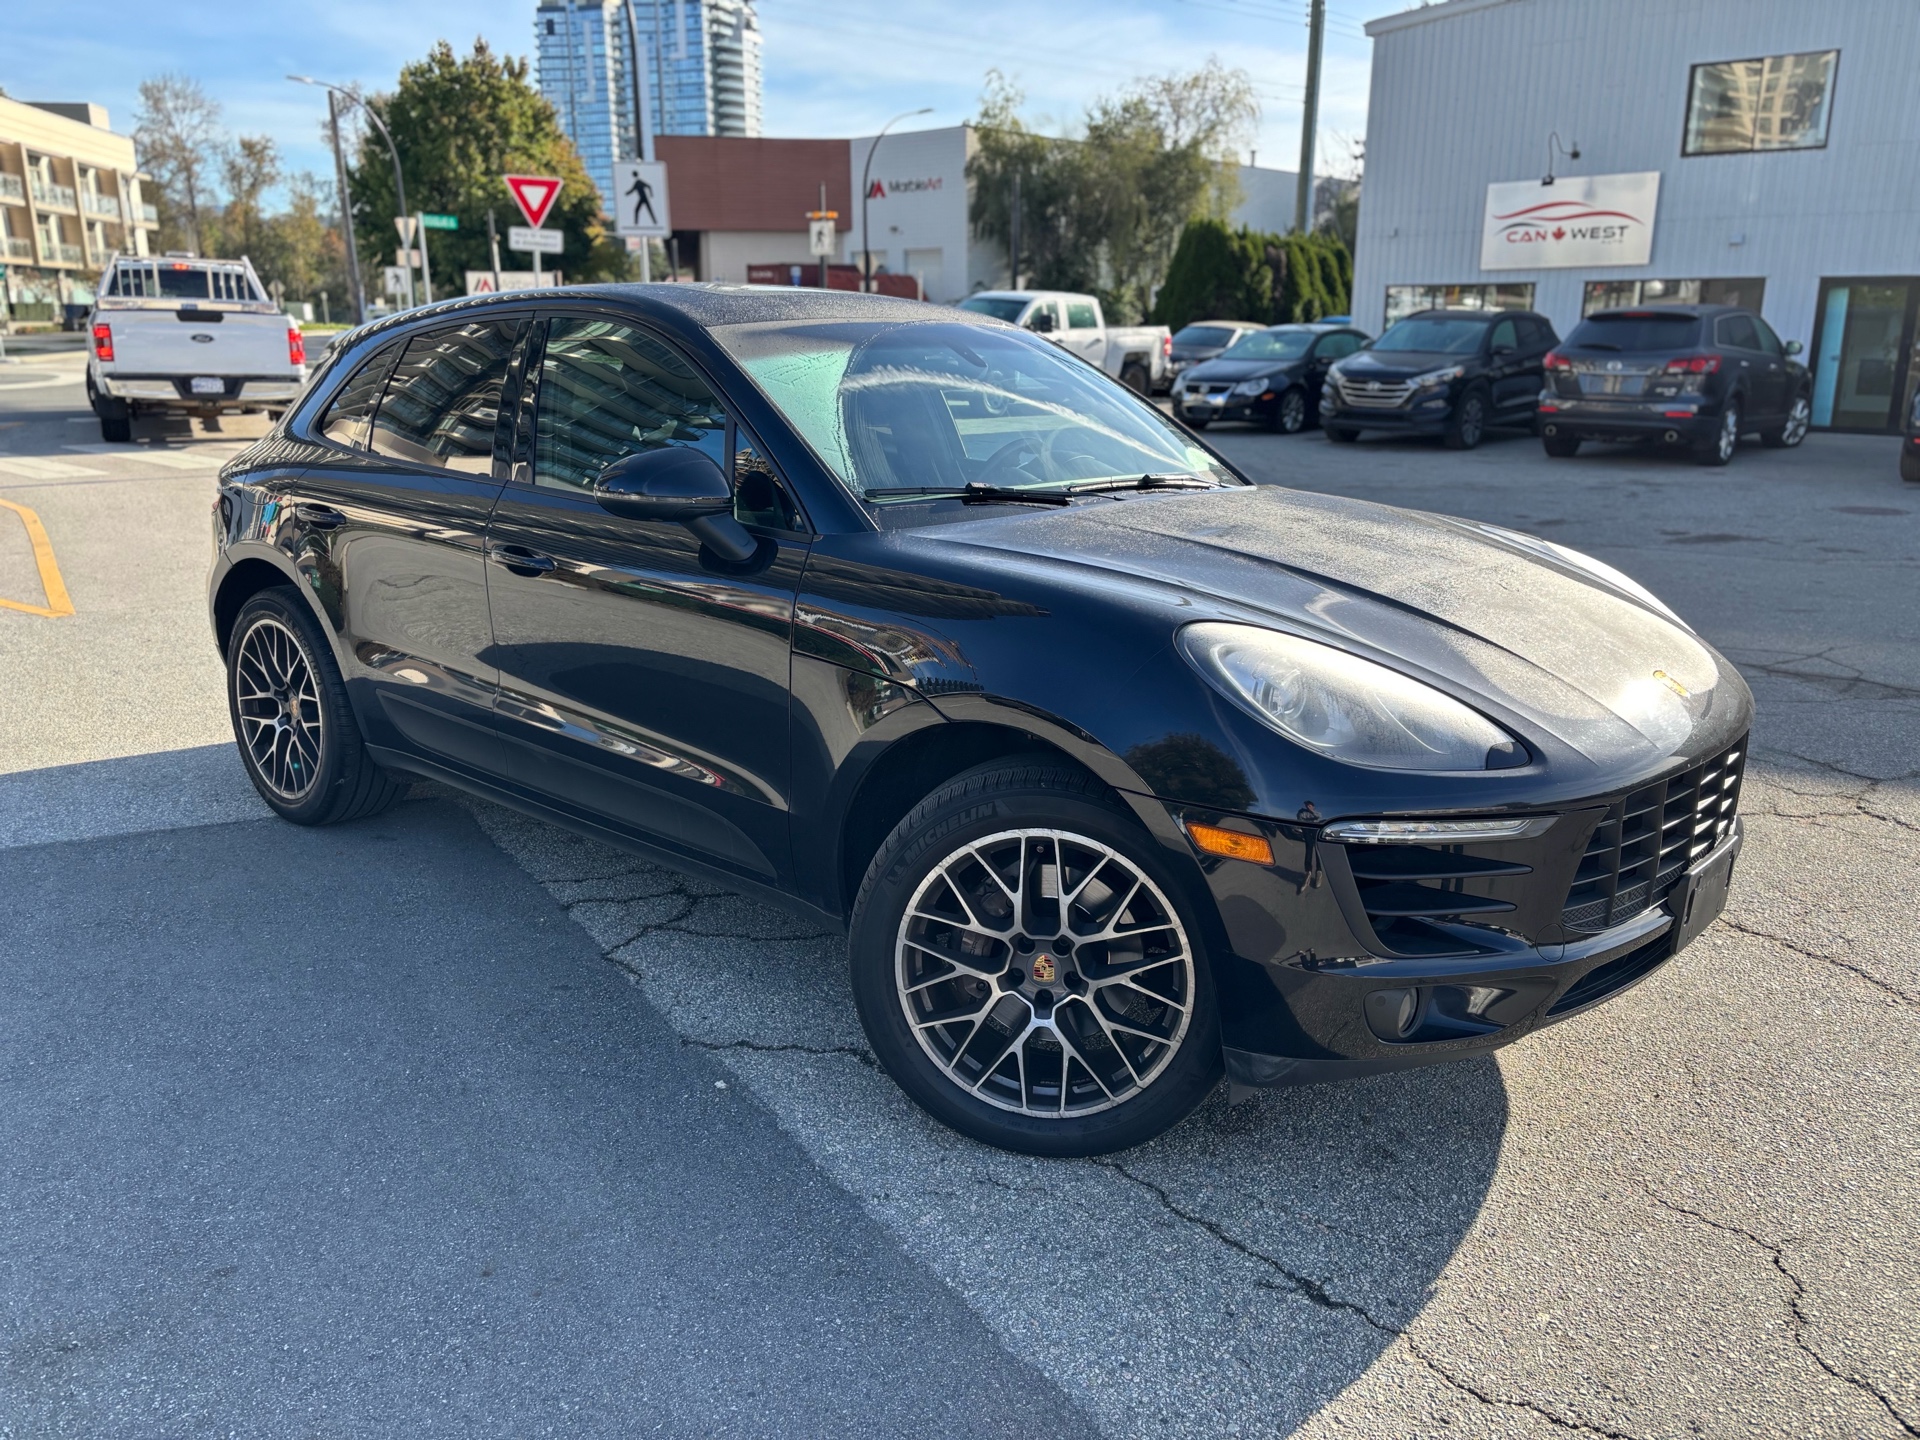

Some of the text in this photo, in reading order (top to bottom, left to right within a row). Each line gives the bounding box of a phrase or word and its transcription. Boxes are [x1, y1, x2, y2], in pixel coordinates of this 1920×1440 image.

[1506, 224, 1629, 244] CAN WEST
[903, 801, 994, 862] MICHELIN
